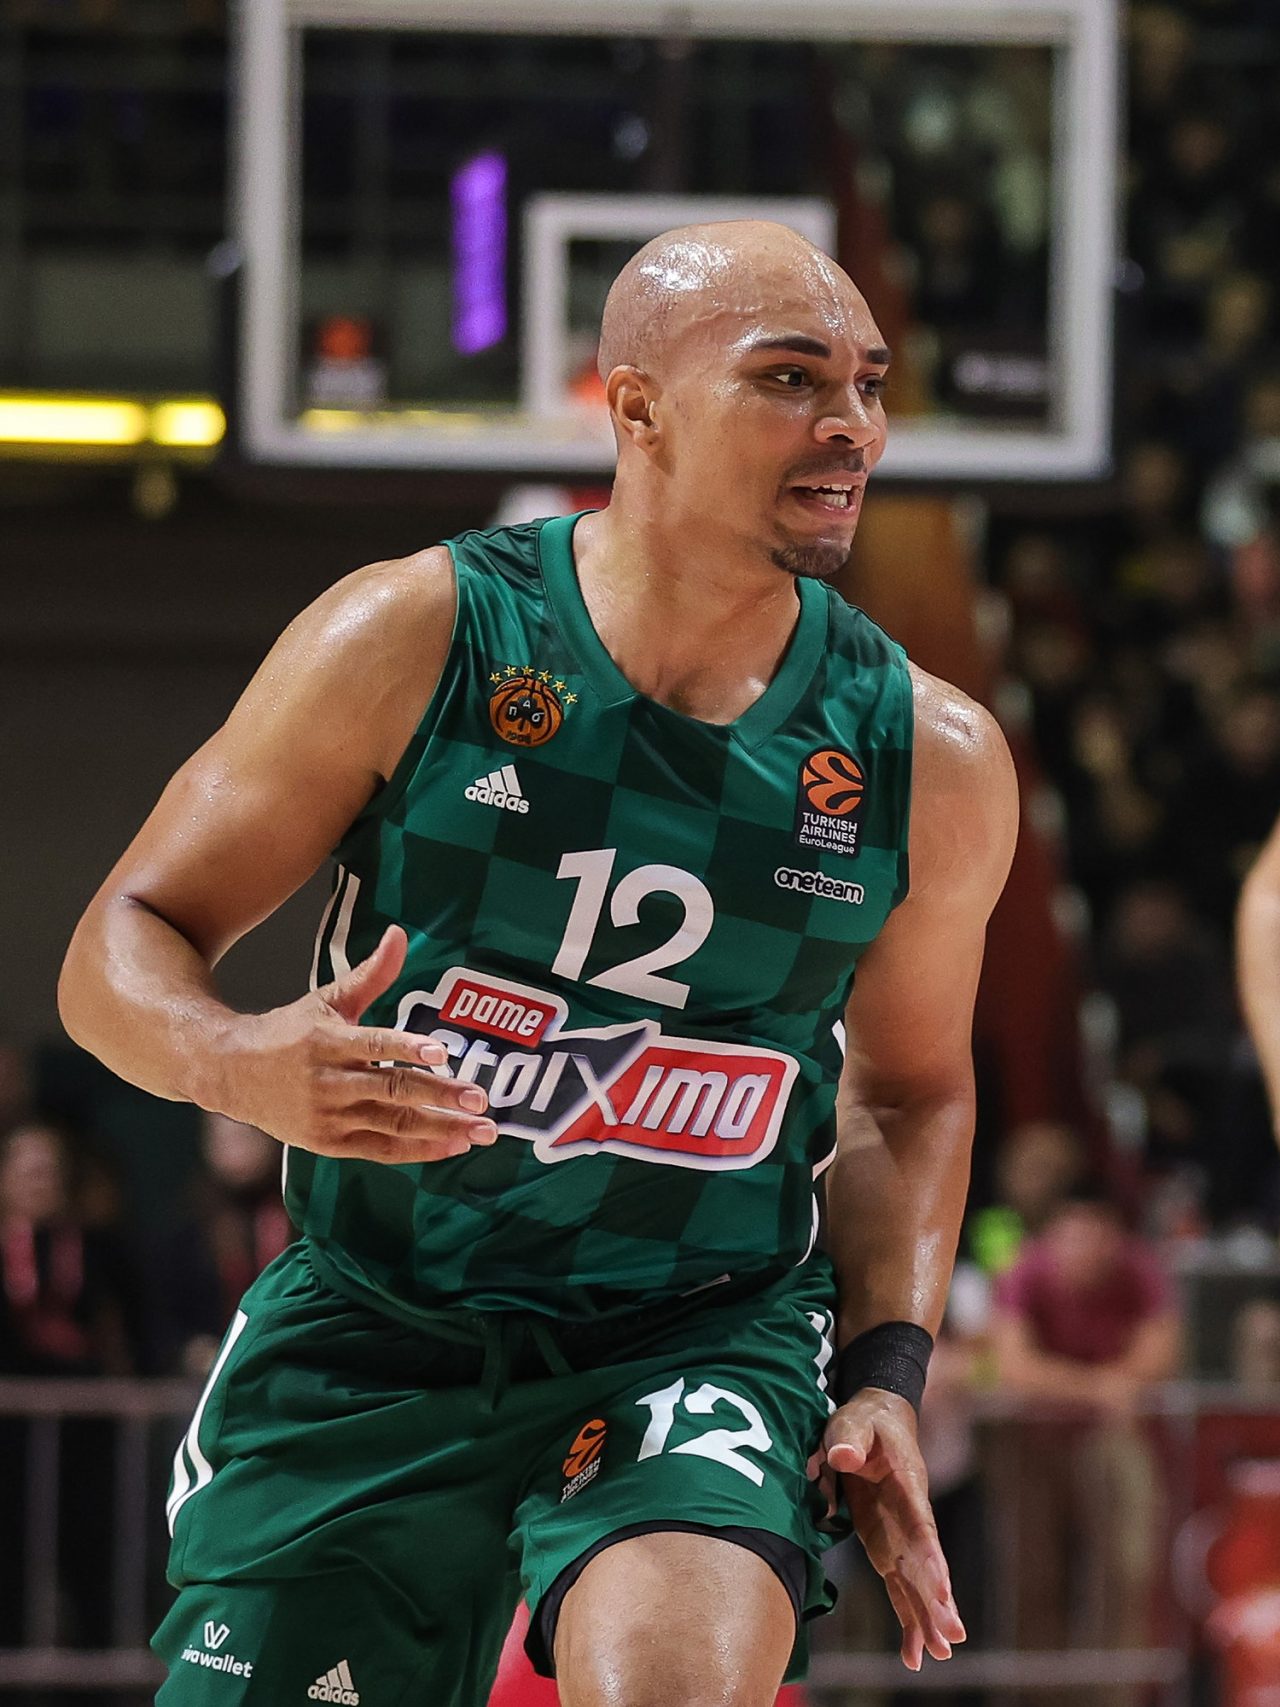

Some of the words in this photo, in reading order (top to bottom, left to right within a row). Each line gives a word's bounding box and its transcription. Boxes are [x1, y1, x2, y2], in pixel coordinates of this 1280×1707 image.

[464, 786, 530, 814] adidas
[800, 824, 856, 845] AIRLINES
[801, 812, 858, 834] TURKISH
[799, 834, 855, 854] EuroLeague
[775, 868, 864, 904] oneteam
[550, 847, 715, 1010] 12
[448, 988, 544, 1037] pame
[634, 1376, 773, 1488] 12
[307, 1683, 360, 1706] adidas
